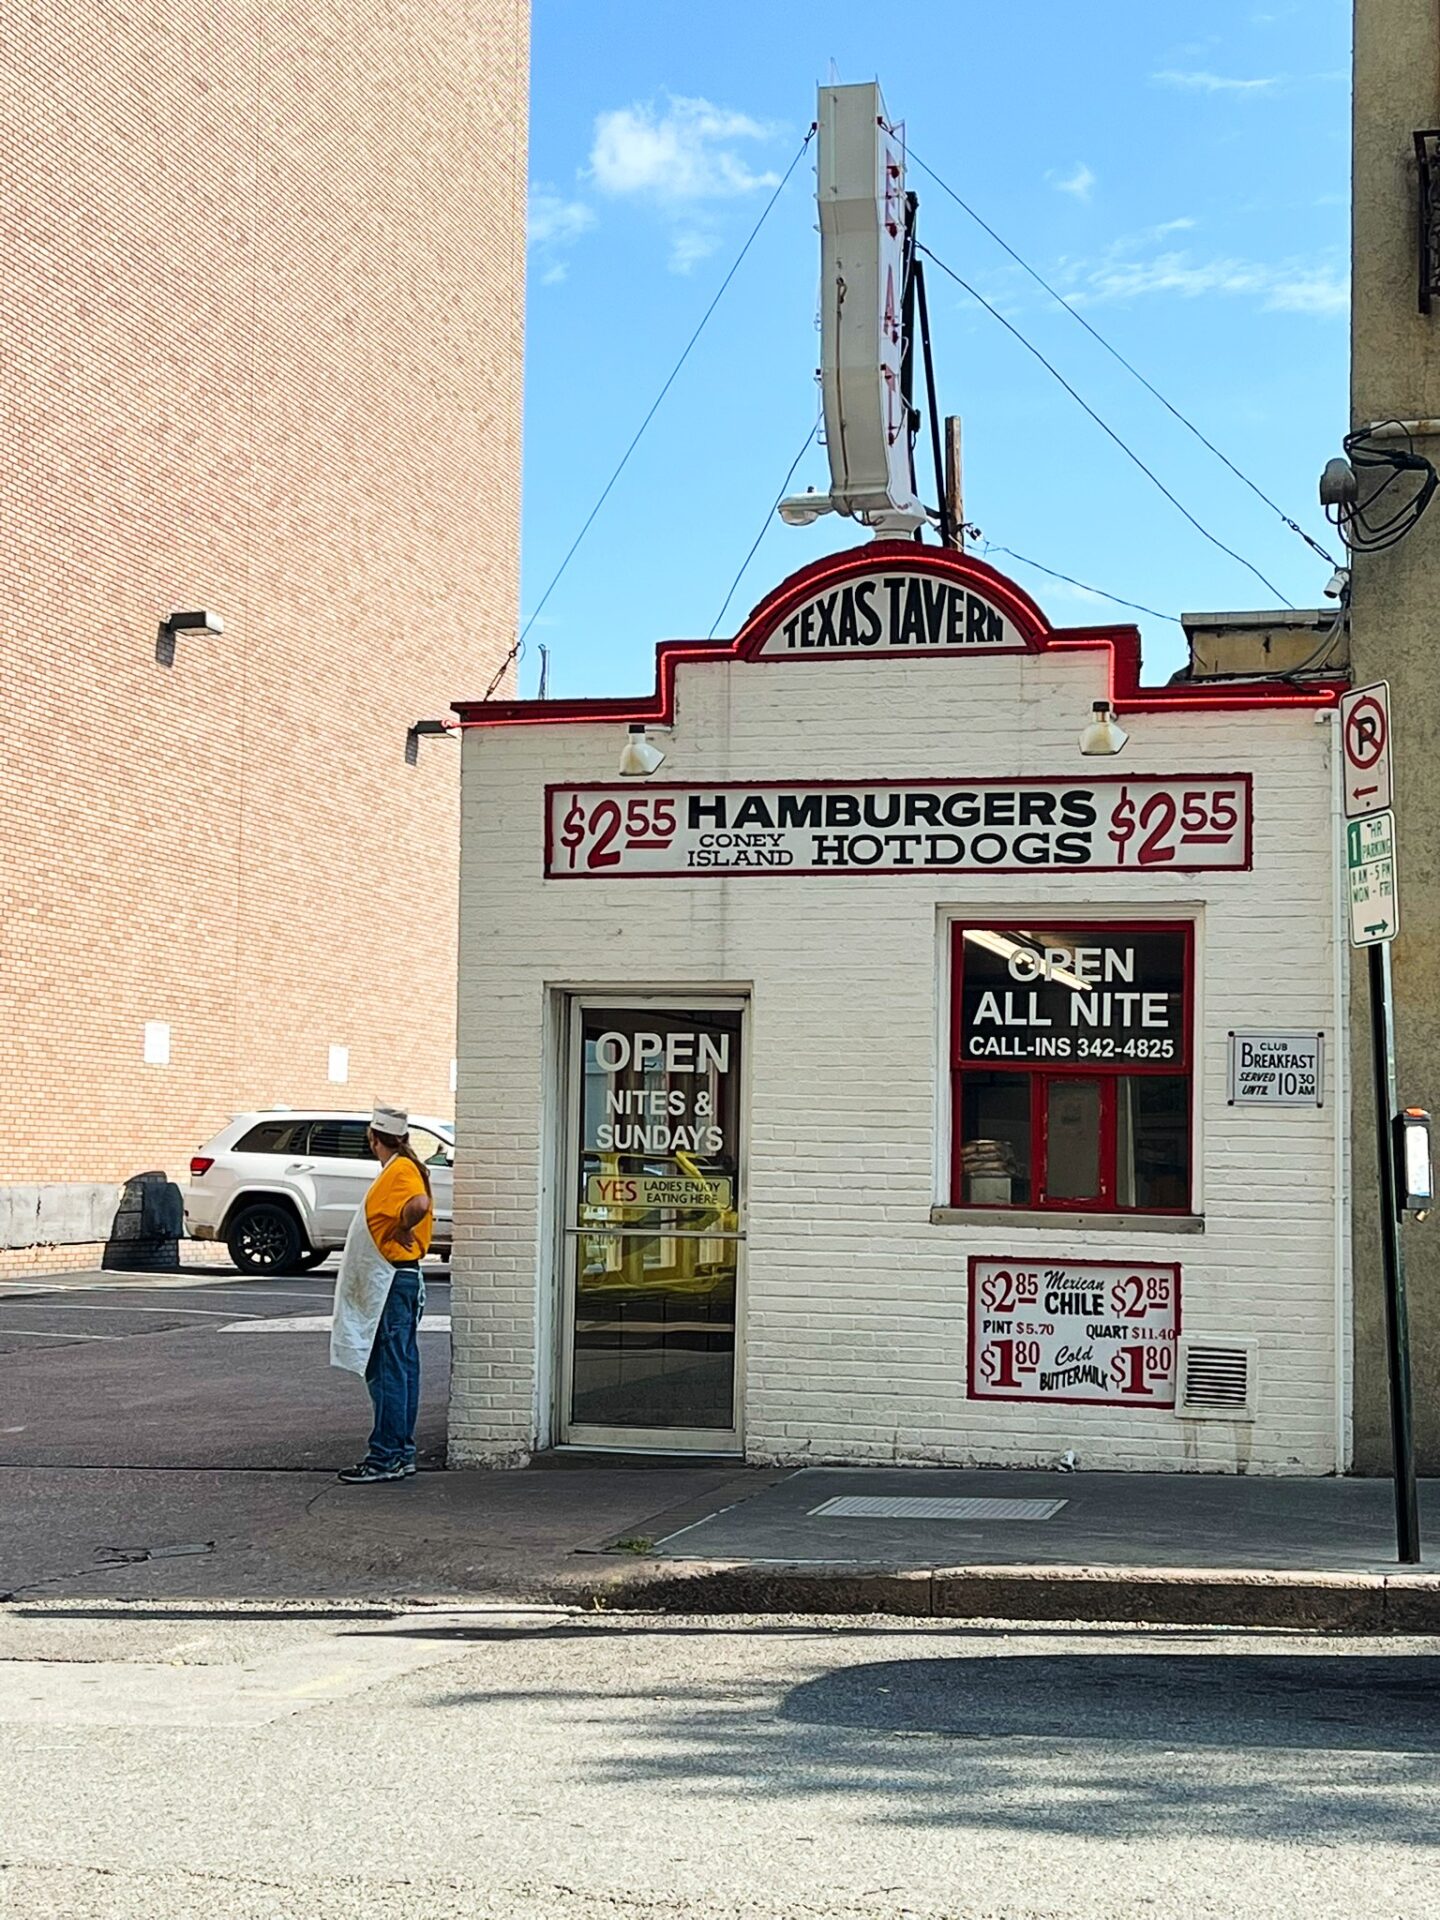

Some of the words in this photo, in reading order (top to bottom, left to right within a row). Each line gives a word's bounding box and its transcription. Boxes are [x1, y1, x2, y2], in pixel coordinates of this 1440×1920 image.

[783, 581, 882, 648] TEXAS
[884, 577, 1003, 644] TAVERN
[687, 790, 1097, 829] HAMBURGERS
[699, 833, 785, 848] CONEY
[811, 831, 1092, 866] HOTDOGS
[1351, 830, 1357, 861] 1
[1371, 821, 1382, 838] HR
[1362, 838, 1391, 859] PARKING
[687, 849, 794, 867] ISLAND
[1008, 947, 1134, 983] OPEN
[972, 991, 1052, 1026] ALL
[1070, 992, 1169, 1028] NITE
[595, 1031, 730, 1074] OPEN
[969, 1036, 1071, 1057] CALL-INS
[1076, 1037, 1174, 1058] 342-4825
[1241, 1042, 1315, 1069] BREAKFAST
[1259, 1042, 1288, 1051] CLUB
[1239, 1071, 1276, 1082] SERVED
[1241, 1085, 1268, 1095] UNTIL
[1298, 1085, 1315, 1095] AM
[606, 1089, 685, 1116] NITES
[694, 1090, 713, 1116] &
[596, 1124, 723, 1151] SUNDAYS
[597, 1179, 637, 1202] YES
[643, 1181, 682, 1193] LADIES
[685, 1181, 720, 1193] ENJOY
[647, 1192, 688, 1204] EATING
[690, 1193, 718, 1205] HERE
[1044, 1270, 1105, 1291] Mexican
[1044, 1292, 1105, 1316] CHILE
[983, 1320, 1013, 1335] PINT
[1016, 1322, 1054, 1336] $5.70
[1086, 1324, 1129, 1340] QUART
[1131, 1327, 1176, 1341] $11.40
[1055, 1345, 1094, 1366] Cold
[1040, 1365, 1109, 1392] BUTTERMILK
